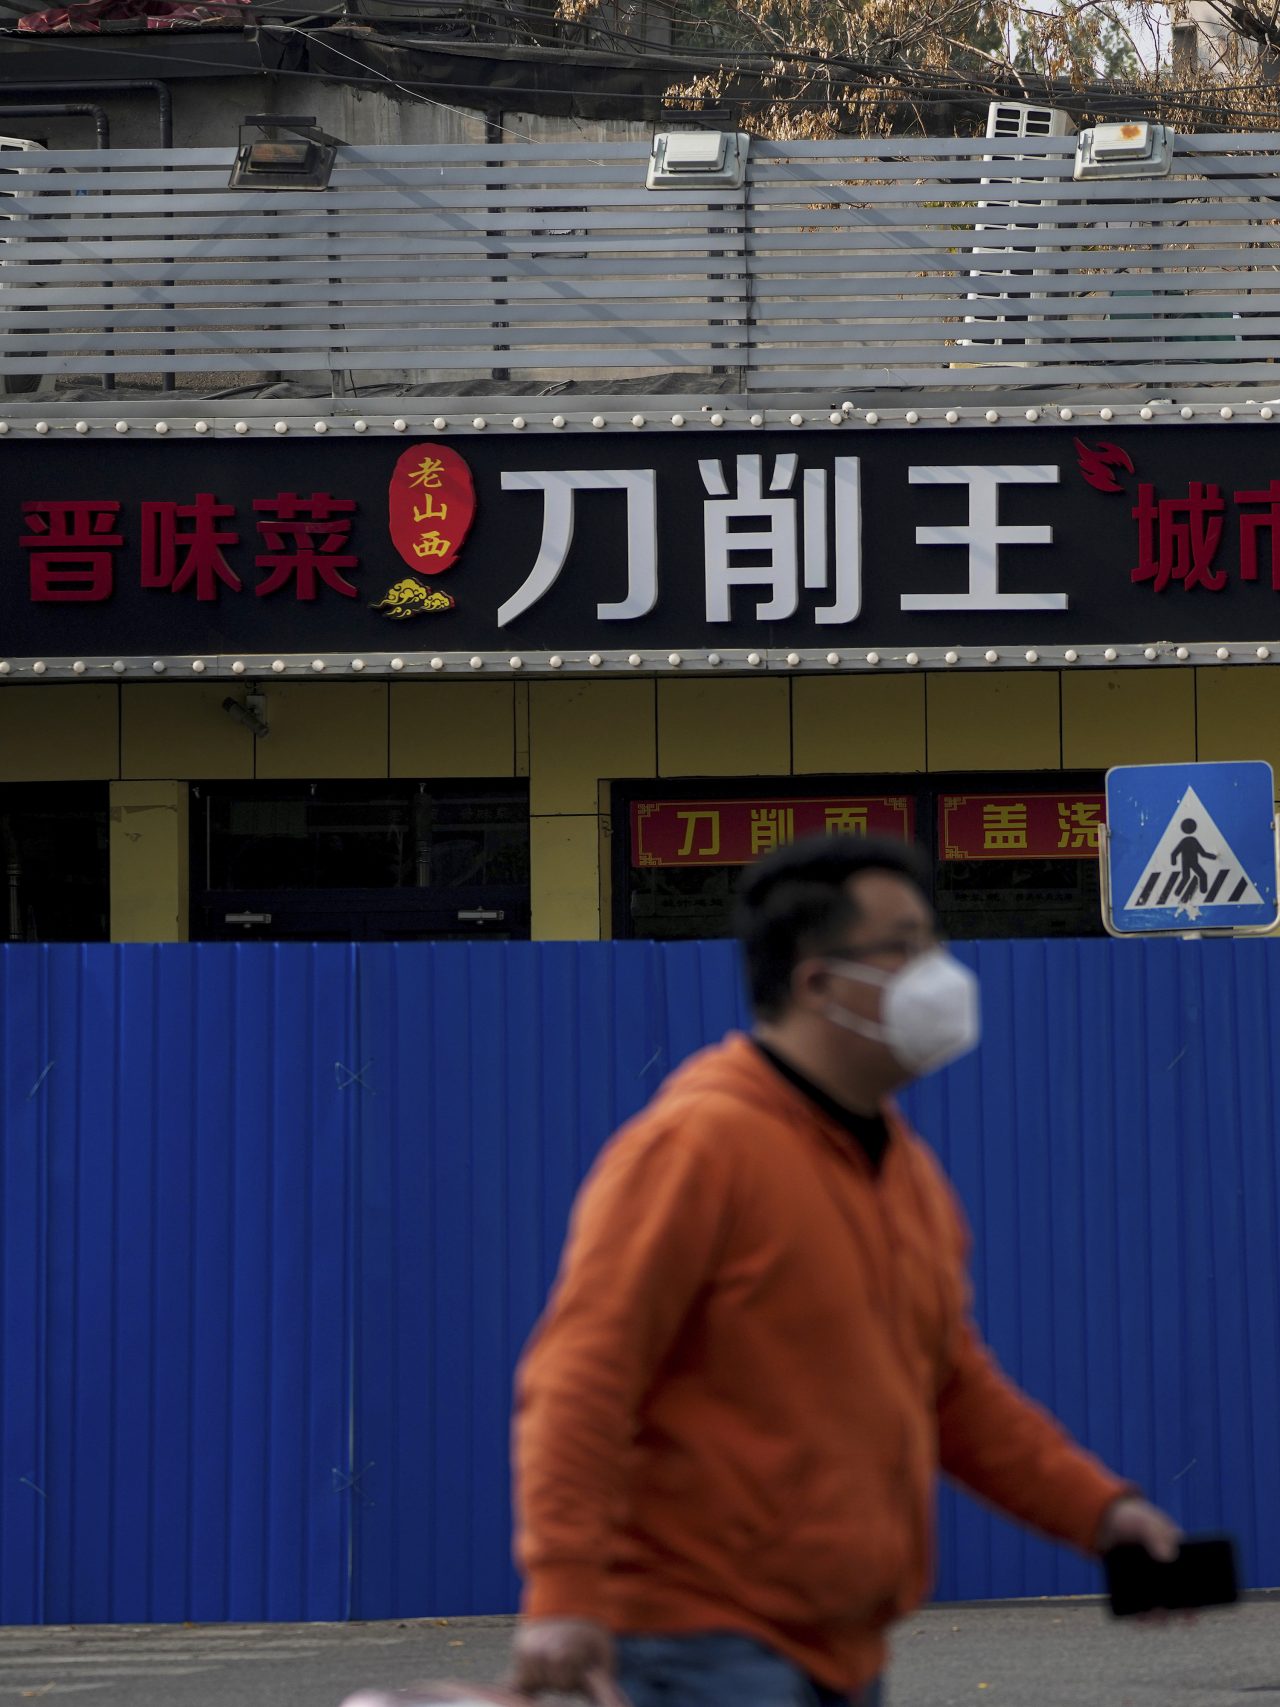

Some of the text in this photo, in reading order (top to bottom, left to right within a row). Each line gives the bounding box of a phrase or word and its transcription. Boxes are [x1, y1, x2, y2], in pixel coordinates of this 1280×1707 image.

[19, 492, 360, 601] 晋味菜
[407, 456, 452, 560] 老山西
[497, 452, 1069, 628] 刀削王
[677, 807, 869, 856] 刀削面
